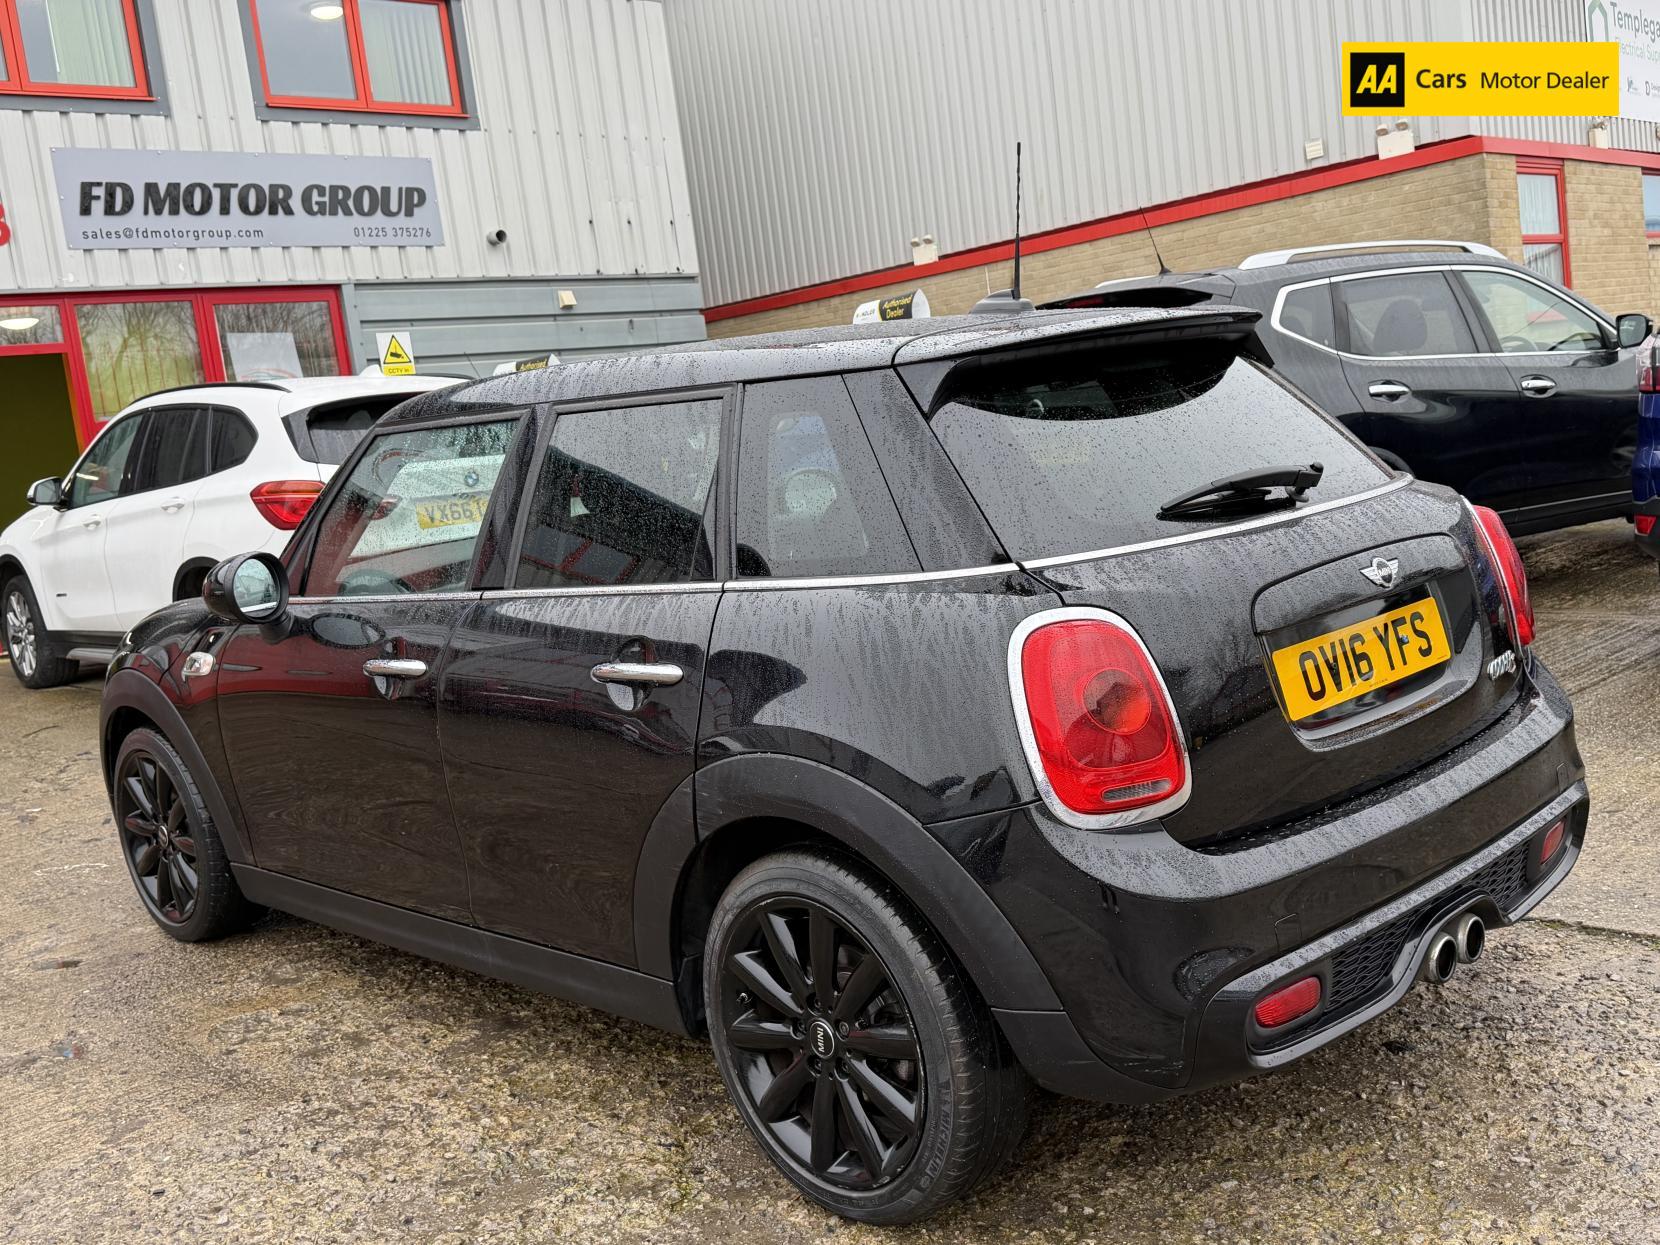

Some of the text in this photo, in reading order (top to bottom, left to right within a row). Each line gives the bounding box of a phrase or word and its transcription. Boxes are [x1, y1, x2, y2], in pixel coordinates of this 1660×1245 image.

[79, 181, 427, 218] FD MOTOR GROUP
[82, 227, 431, 241] sales@fdmotorgroup.com 01225 375276
[886, 307, 904, 319] Dealer
[1299, 611, 1432, 701] OV16 YFS
[816, 1026, 825, 1053] MINI
